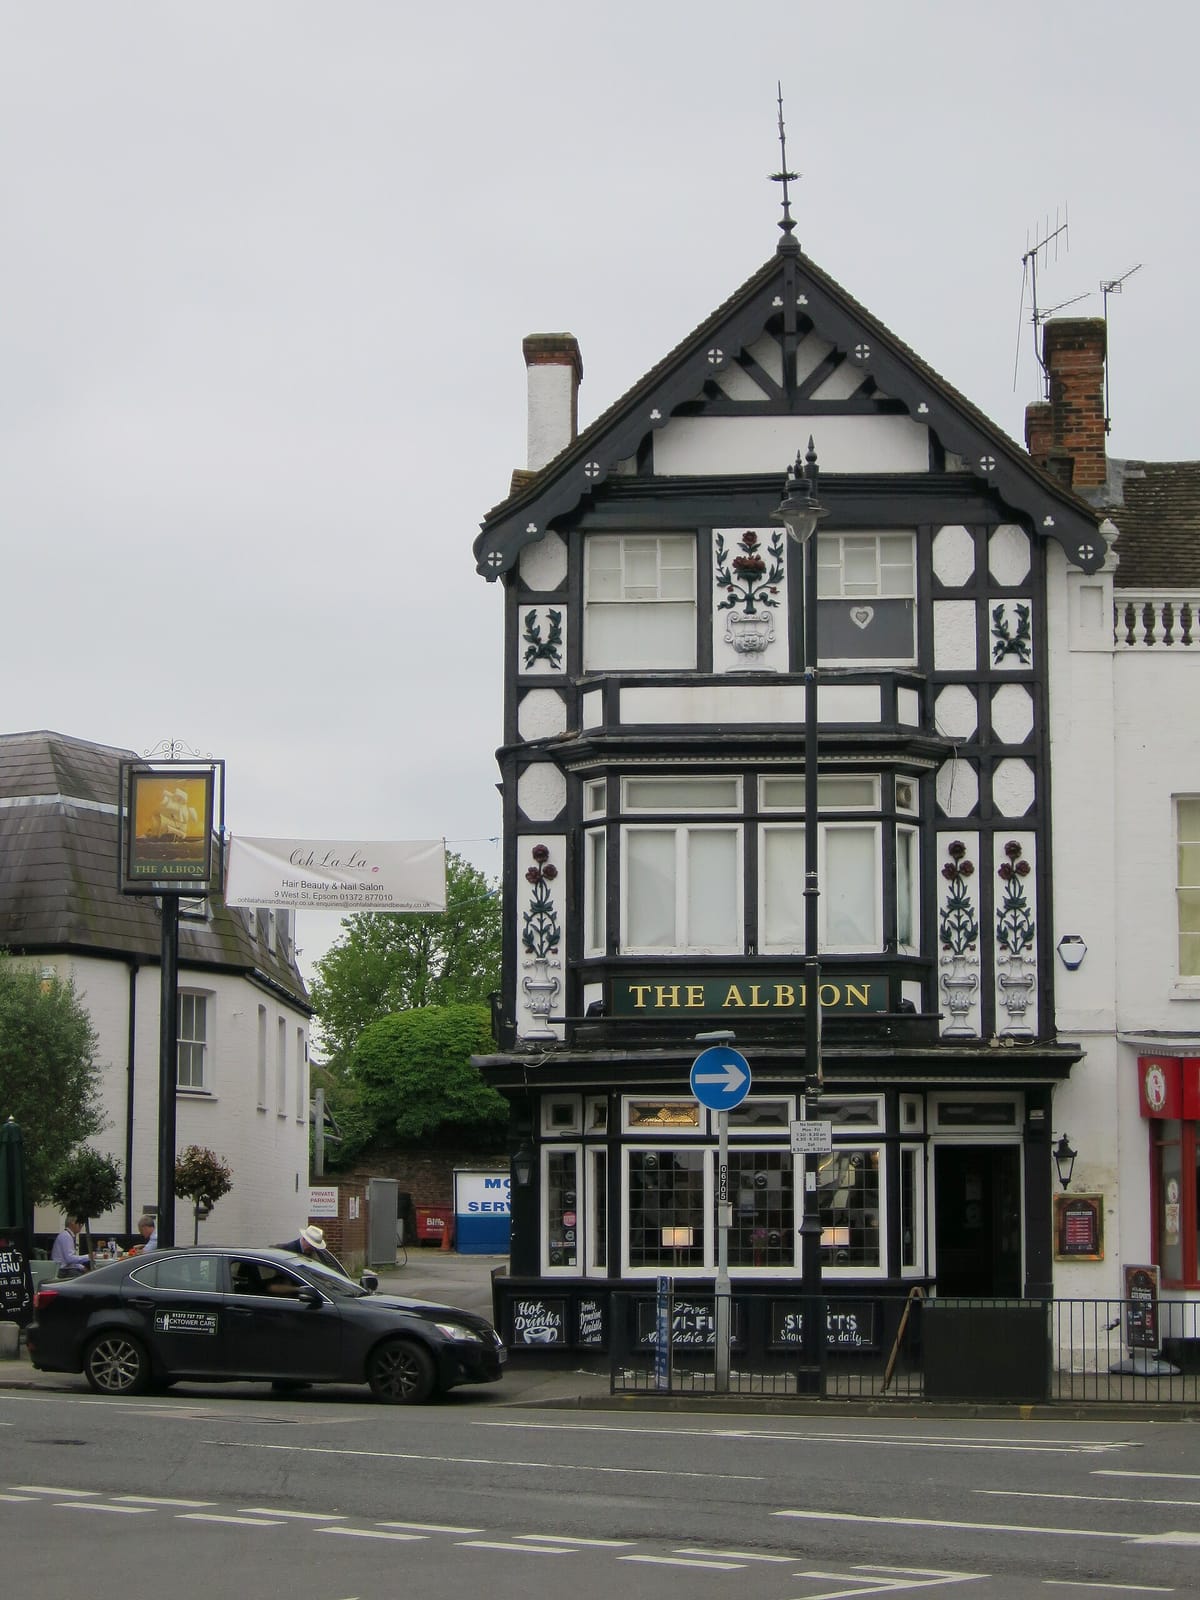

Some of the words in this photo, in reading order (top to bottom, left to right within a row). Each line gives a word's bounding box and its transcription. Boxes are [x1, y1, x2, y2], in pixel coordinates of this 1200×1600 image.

[290, 848, 314, 866] Ooh
[316, 849, 340, 868] La
[341, 849, 367, 868] La
[134, 865, 158, 873] THE
[161, 865, 205, 873] ALBION
[282, 880, 299, 888] Hair
[300, 881, 330, 891] Beauty
[341, 883, 358, 891] Nail
[359, 883, 384, 891] Salon
[274, 890, 280, 898] 9
[280, 891, 300, 899] West
[312, 893, 338, 902] Epsom
[339, 893, 364, 901] 01372
[364, 893, 393, 902] 877010
[628, 985, 706, 1008] THE
[721, 984, 871, 1007] ALBION
[0, 1262, 20, 1273] ENU
[518, 1301, 545, 1316] Hot
[156, 1317, 199, 1326] CLCKTOWER
[514, 1311, 561, 1330] Drinks
[784, 1313, 858, 1331] SPTS
[837, 1331, 861, 1346] daily
